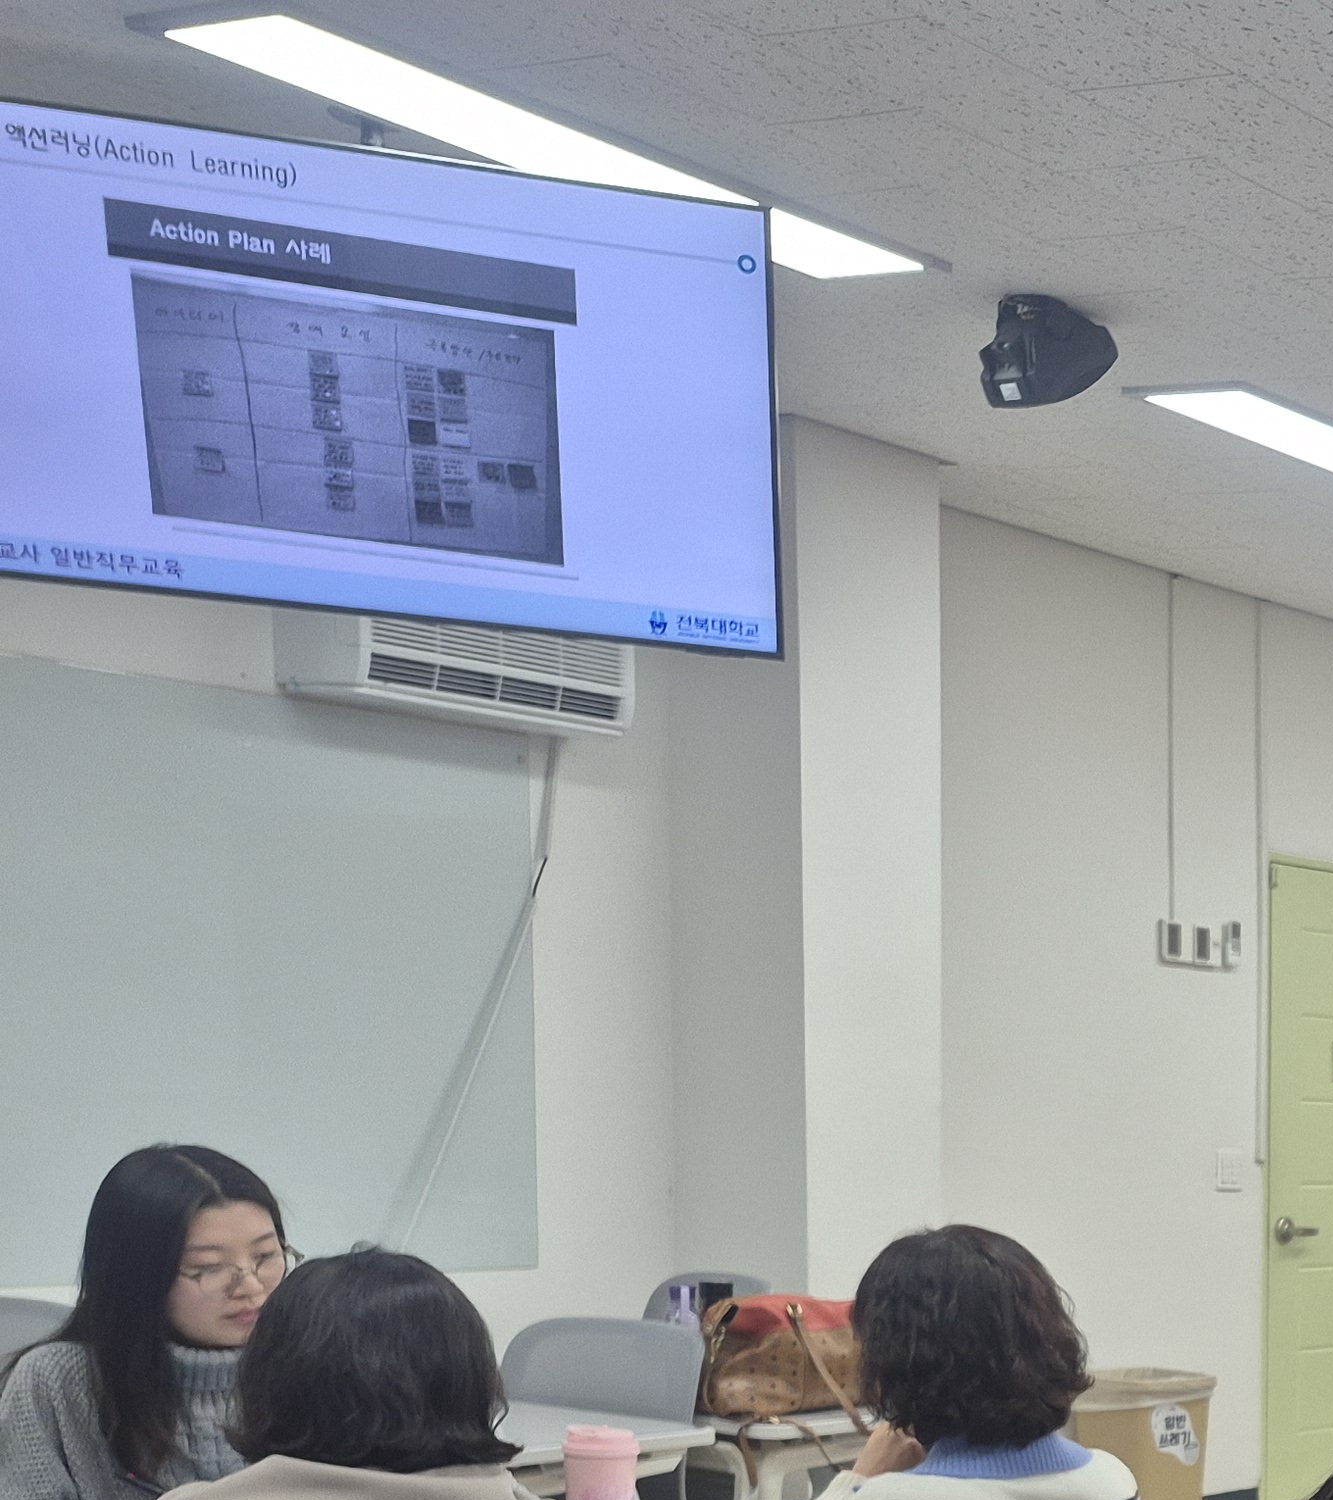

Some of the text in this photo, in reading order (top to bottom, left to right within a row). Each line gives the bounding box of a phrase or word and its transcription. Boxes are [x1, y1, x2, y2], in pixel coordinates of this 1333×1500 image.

[5, 122, 298, 188] 액션러닝(Action Learning)
[150, 218, 332, 264] Action Plan 사례
[50, 547, 185, 579] 일반직무교육
[676, 614, 760, 638] 전북대학교
[1164, 1414, 1187, 1431] 일반
[1159, 1430, 1191, 1449] 쓰레기
